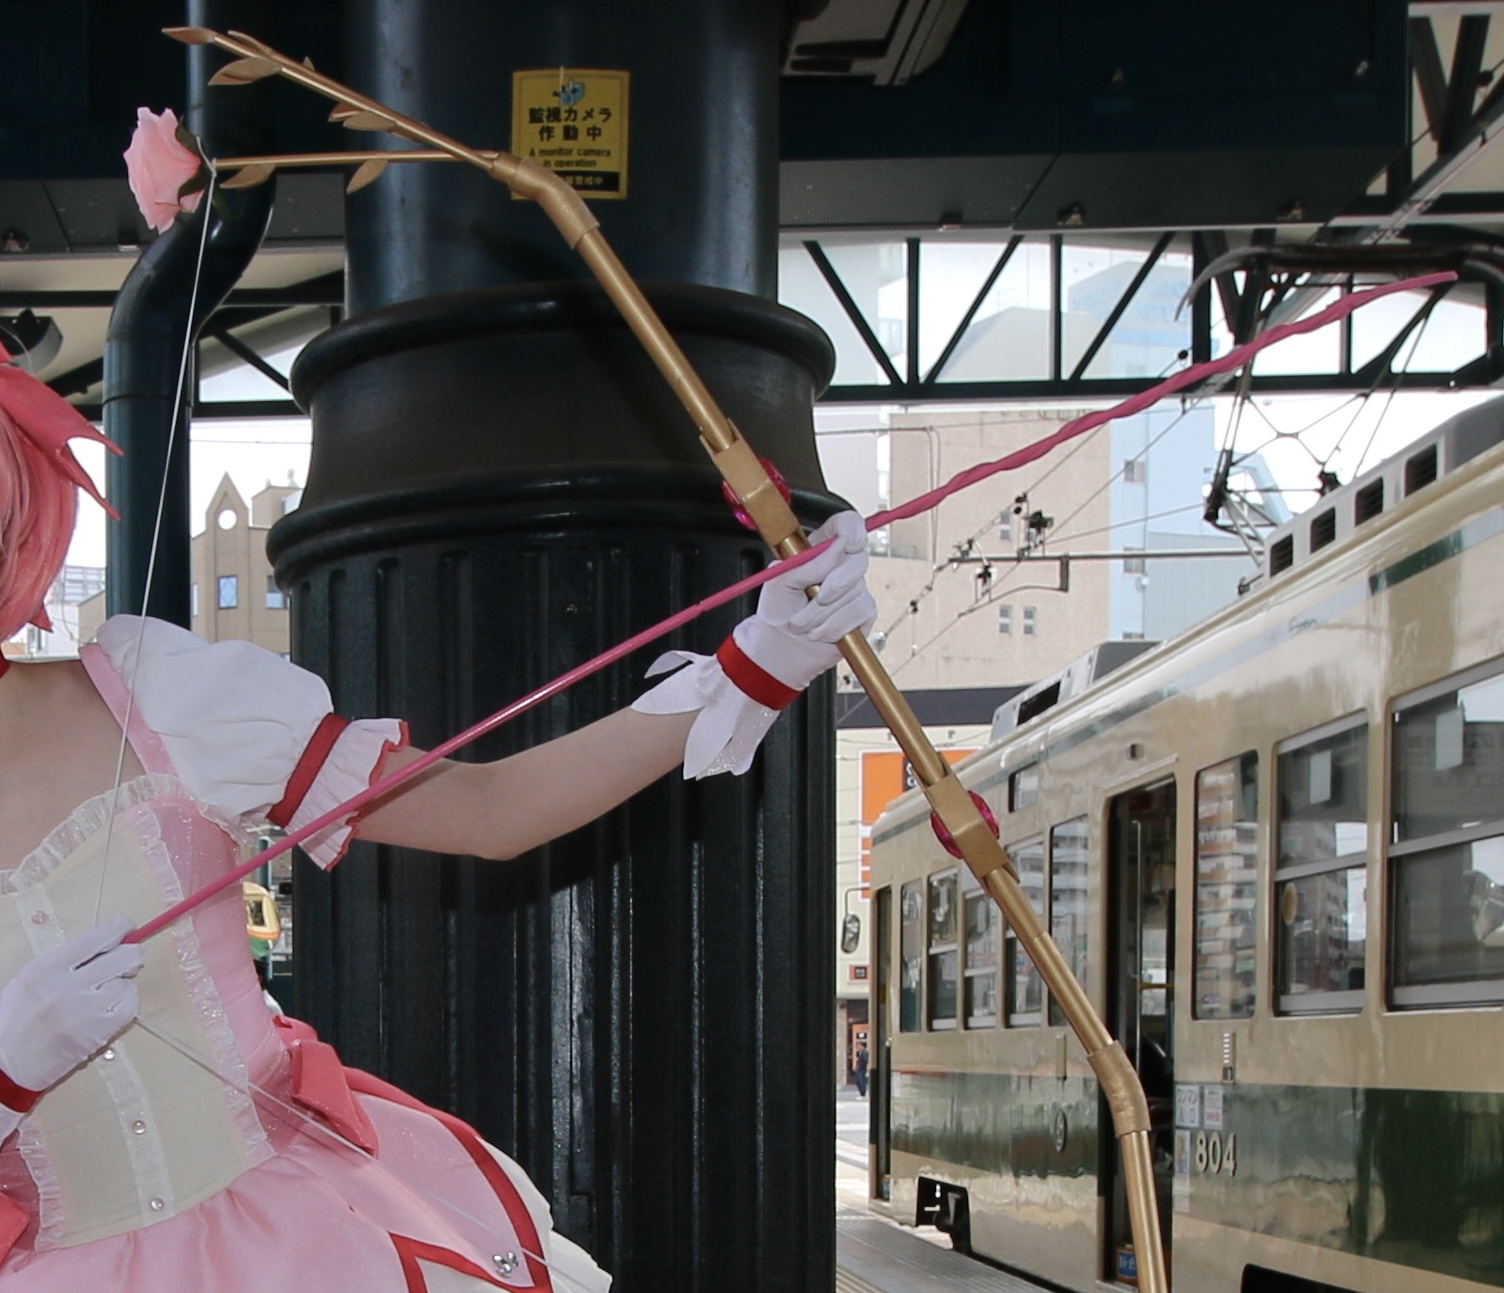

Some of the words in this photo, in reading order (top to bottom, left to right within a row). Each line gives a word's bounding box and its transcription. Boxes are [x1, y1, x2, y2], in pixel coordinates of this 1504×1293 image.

[528, 107, 612, 124] 監視カメラ
[539, 125, 602, 141] 作動中
[529, 148, 536, 156] A
[538, 147, 573, 156] monitor
[577, 148, 611, 157] camera
[554, 159, 597, 168] operation
[1196, 1129, 1238, 1177] 804
